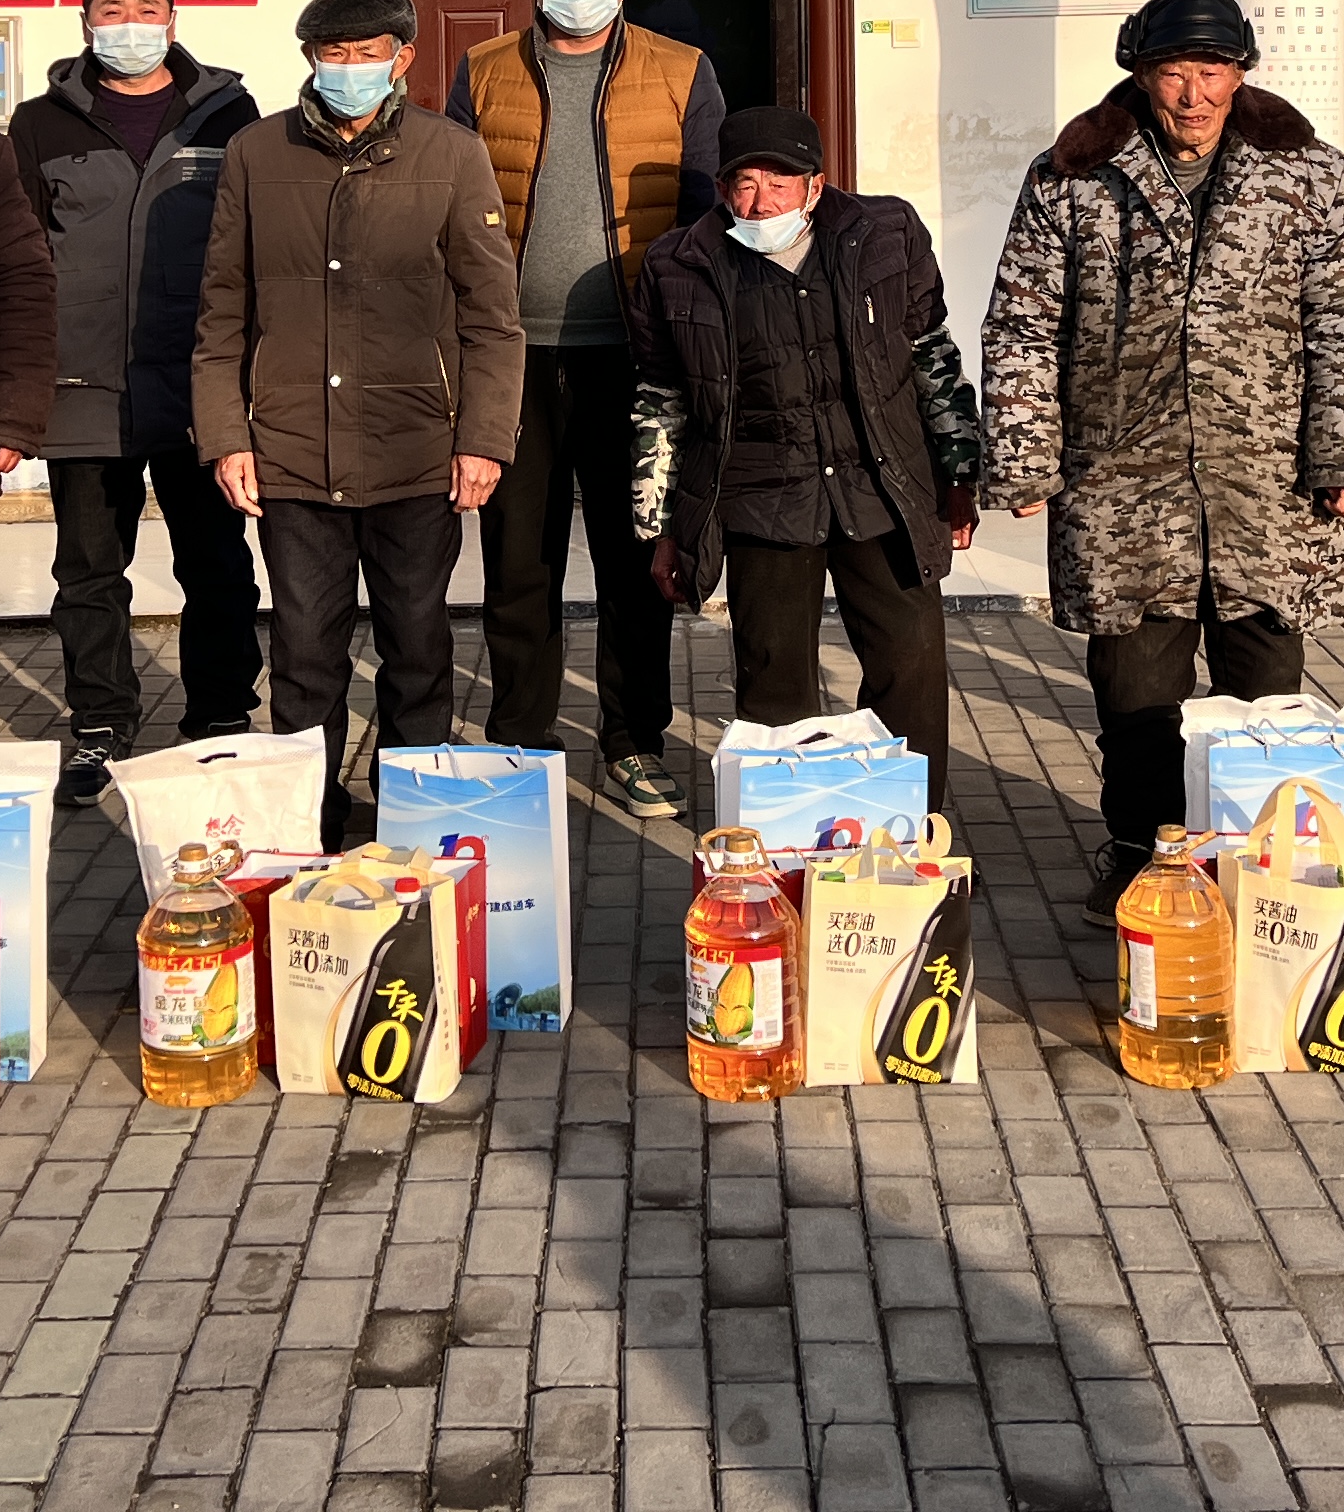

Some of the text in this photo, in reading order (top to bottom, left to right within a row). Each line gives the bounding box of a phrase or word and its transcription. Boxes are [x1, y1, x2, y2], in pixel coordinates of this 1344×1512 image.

[205, 813, 245, 838] 想念
[486, 899, 535, 912] 建成通车
[1254, 897, 1297, 923] 买酱油
[827, 912, 875, 931] 买酱油
[1254, 919, 1318, 950] 选0添加
[287, 928, 329, 951] 买酱油
[826, 932, 896, 957] 选0添加
[288, 949, 349, 976] 选0添加
[924, 954, 962, 998] 千禾
[375, 979, 424, 1022] 千禾
[903, 995, 950, 1064] 0
[361, 1019, 411, 1085] 0
[885, 1055, 942, 1084] 零添加酱油
